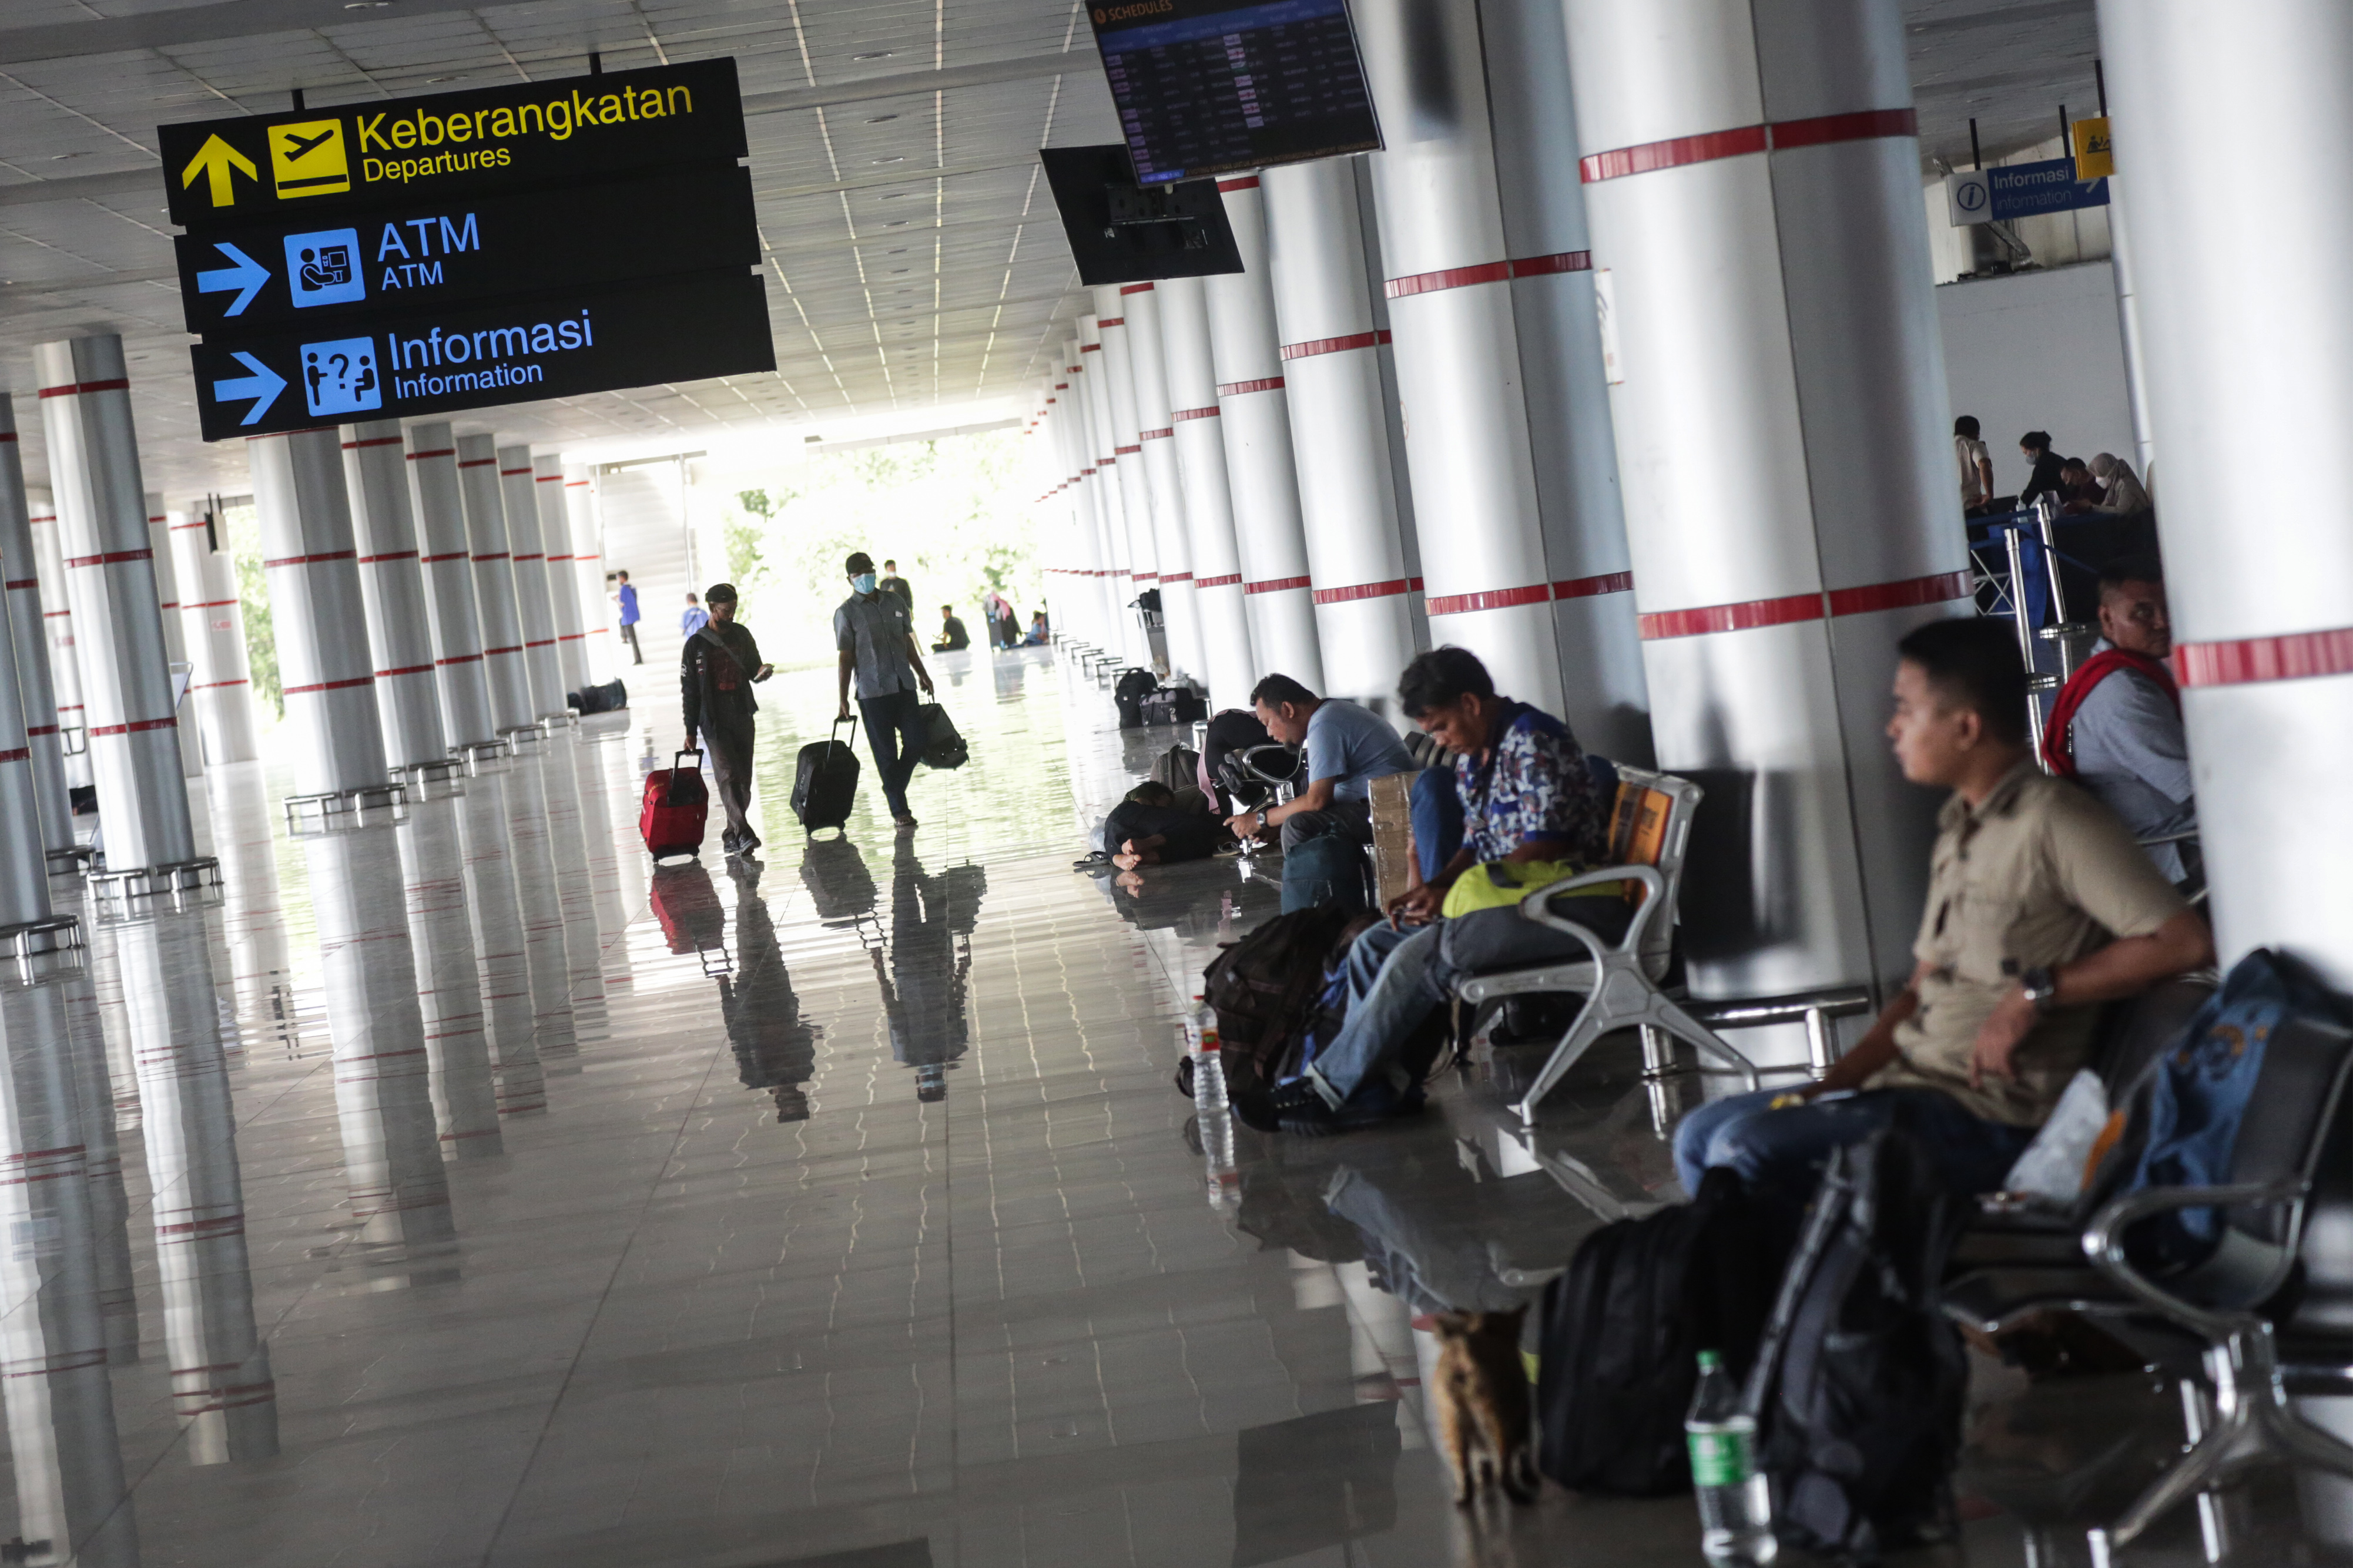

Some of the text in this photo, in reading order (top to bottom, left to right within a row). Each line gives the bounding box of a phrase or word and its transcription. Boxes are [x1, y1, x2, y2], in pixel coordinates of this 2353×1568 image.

[1108, 0, 1173, 21] SCHEDULES
[357, 85, 693, 153] Keberangkatan
[363, 147, 511, 184] Departures
[1995, 165, 2069, 189] Informasi
[377, 213, 480, 262] ATM
[381, 260, 444, 291] ATM
[388, 308, 593, 371] Informasi
[394, 362, 543, 399] Information
